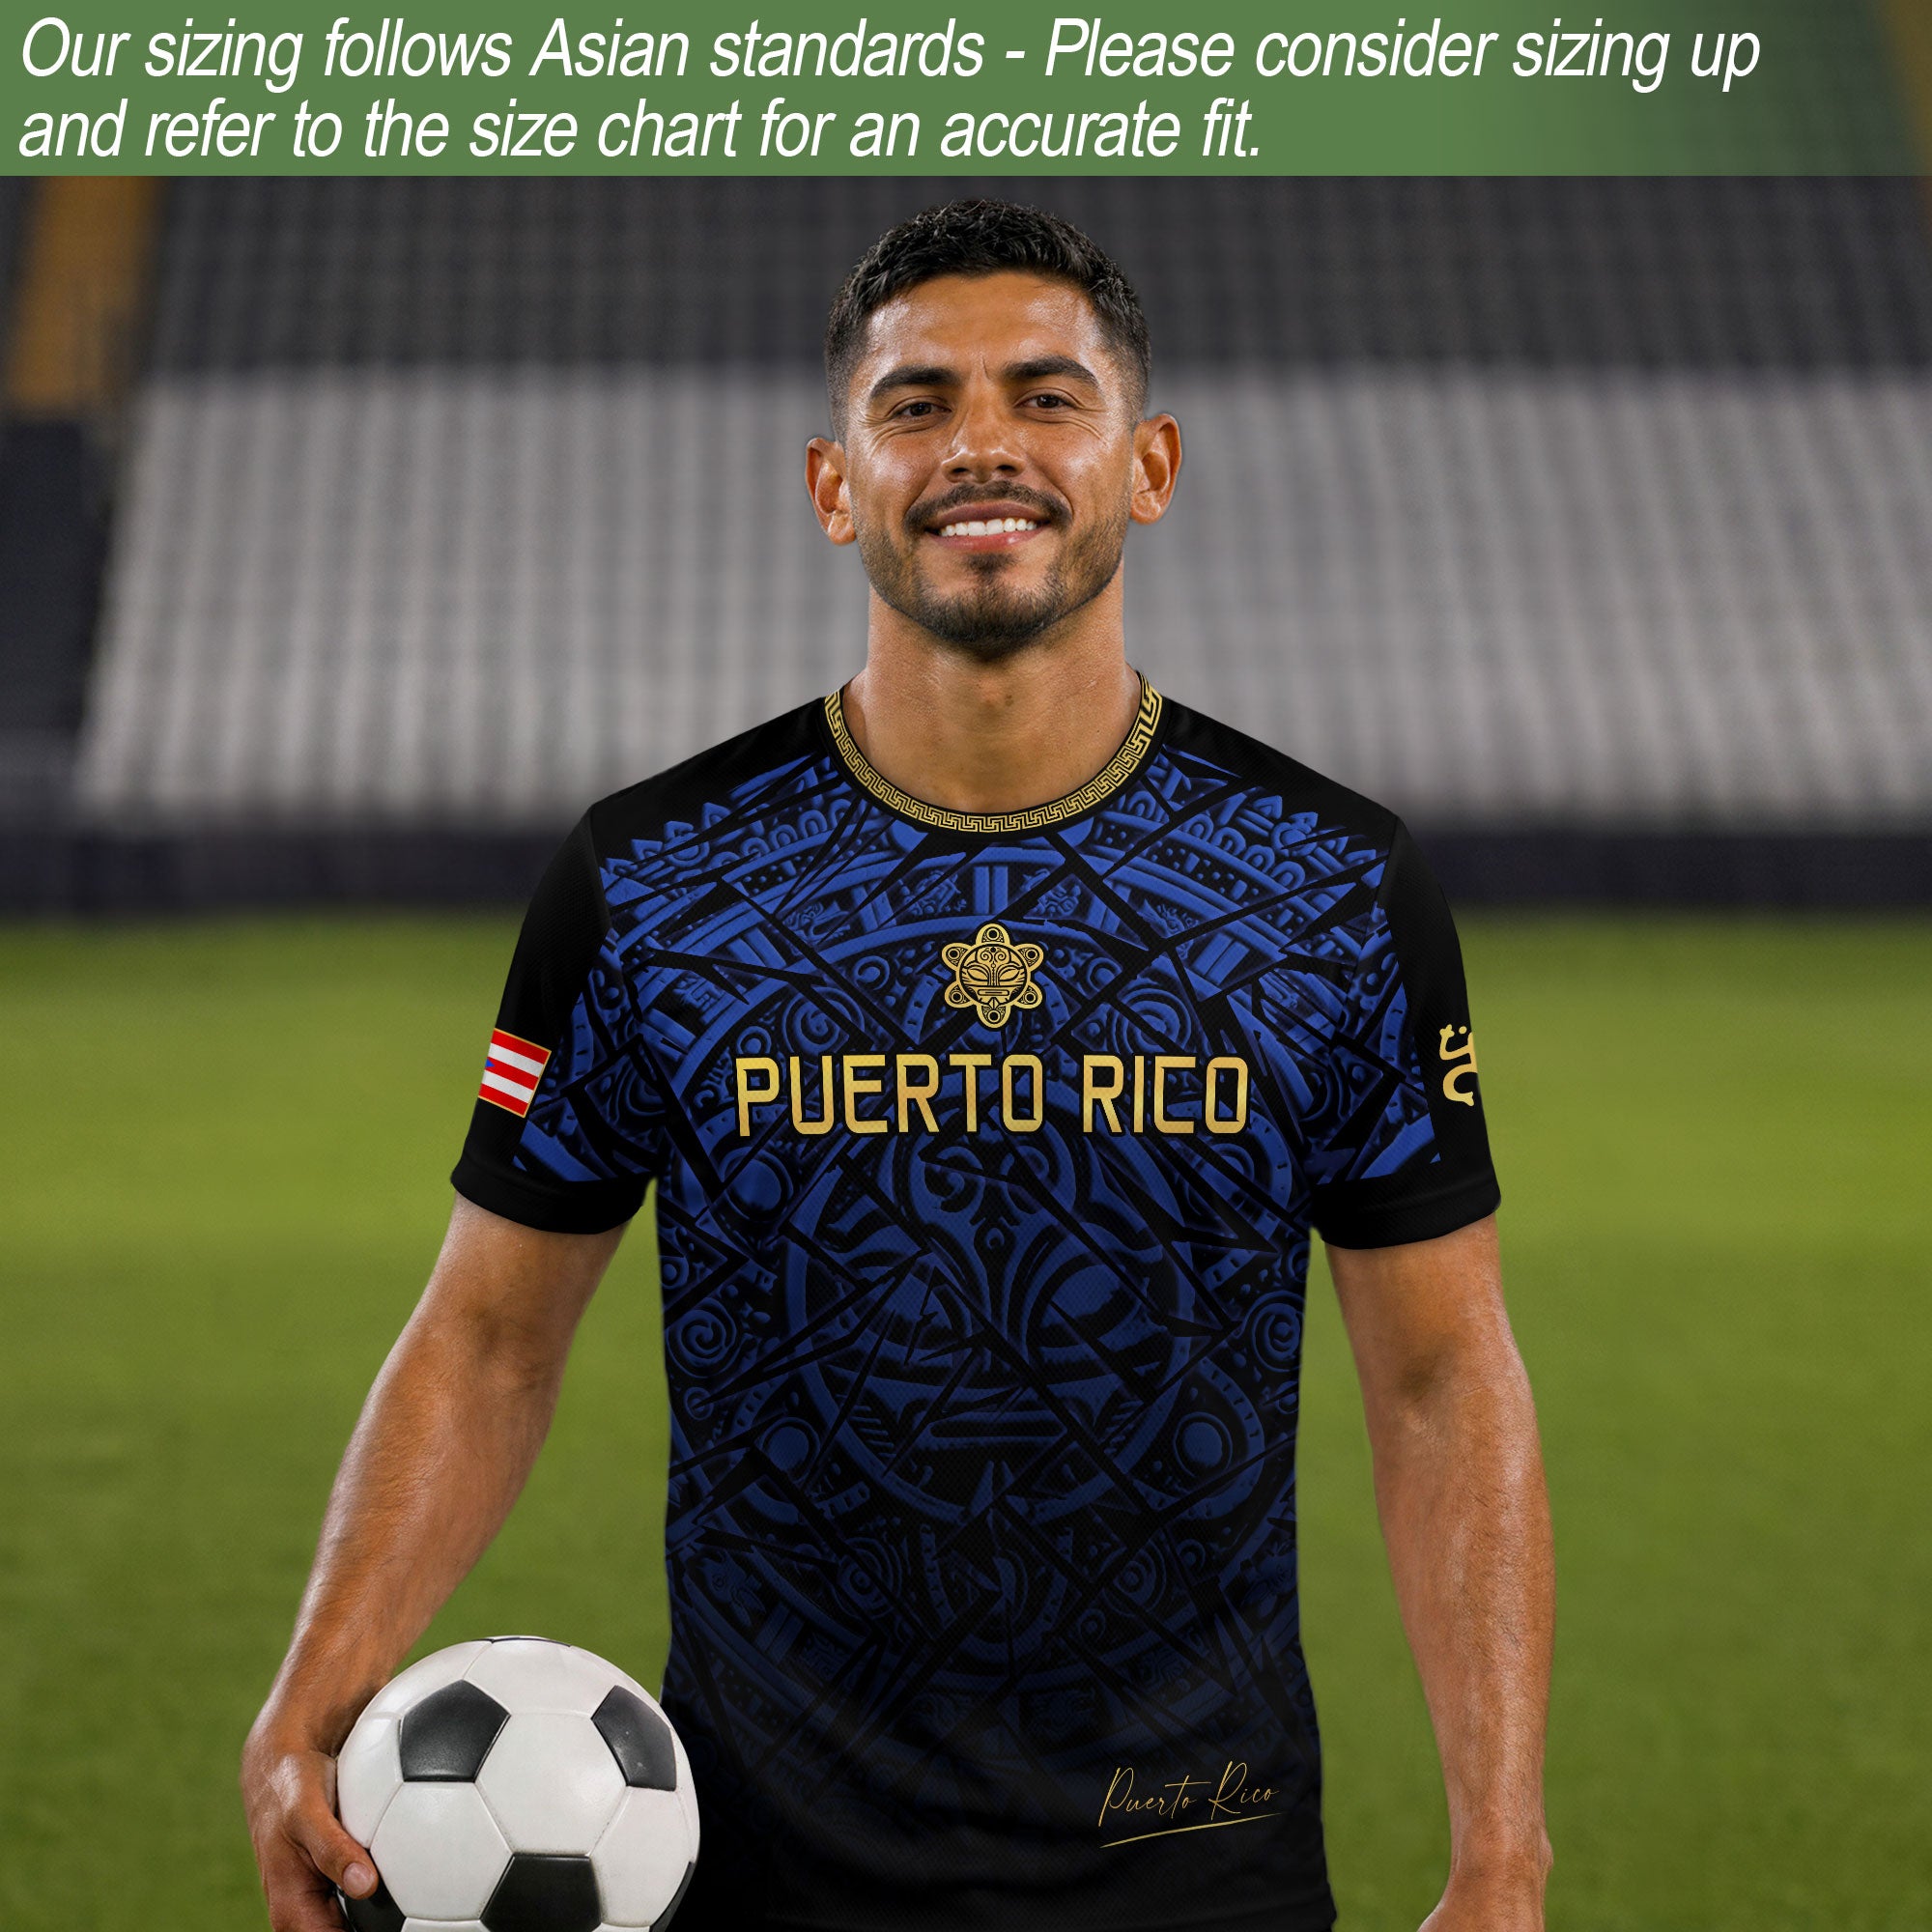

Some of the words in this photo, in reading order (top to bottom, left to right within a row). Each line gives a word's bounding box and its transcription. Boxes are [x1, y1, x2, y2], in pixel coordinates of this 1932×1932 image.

[736, 1054, 1043, 1136] PUERTO
[1083, 1055, 1248, 1133] RICO
[1097, 1767, 1211, 1828] Puerto
[1208, 1760, 1280, 1821] Rico
